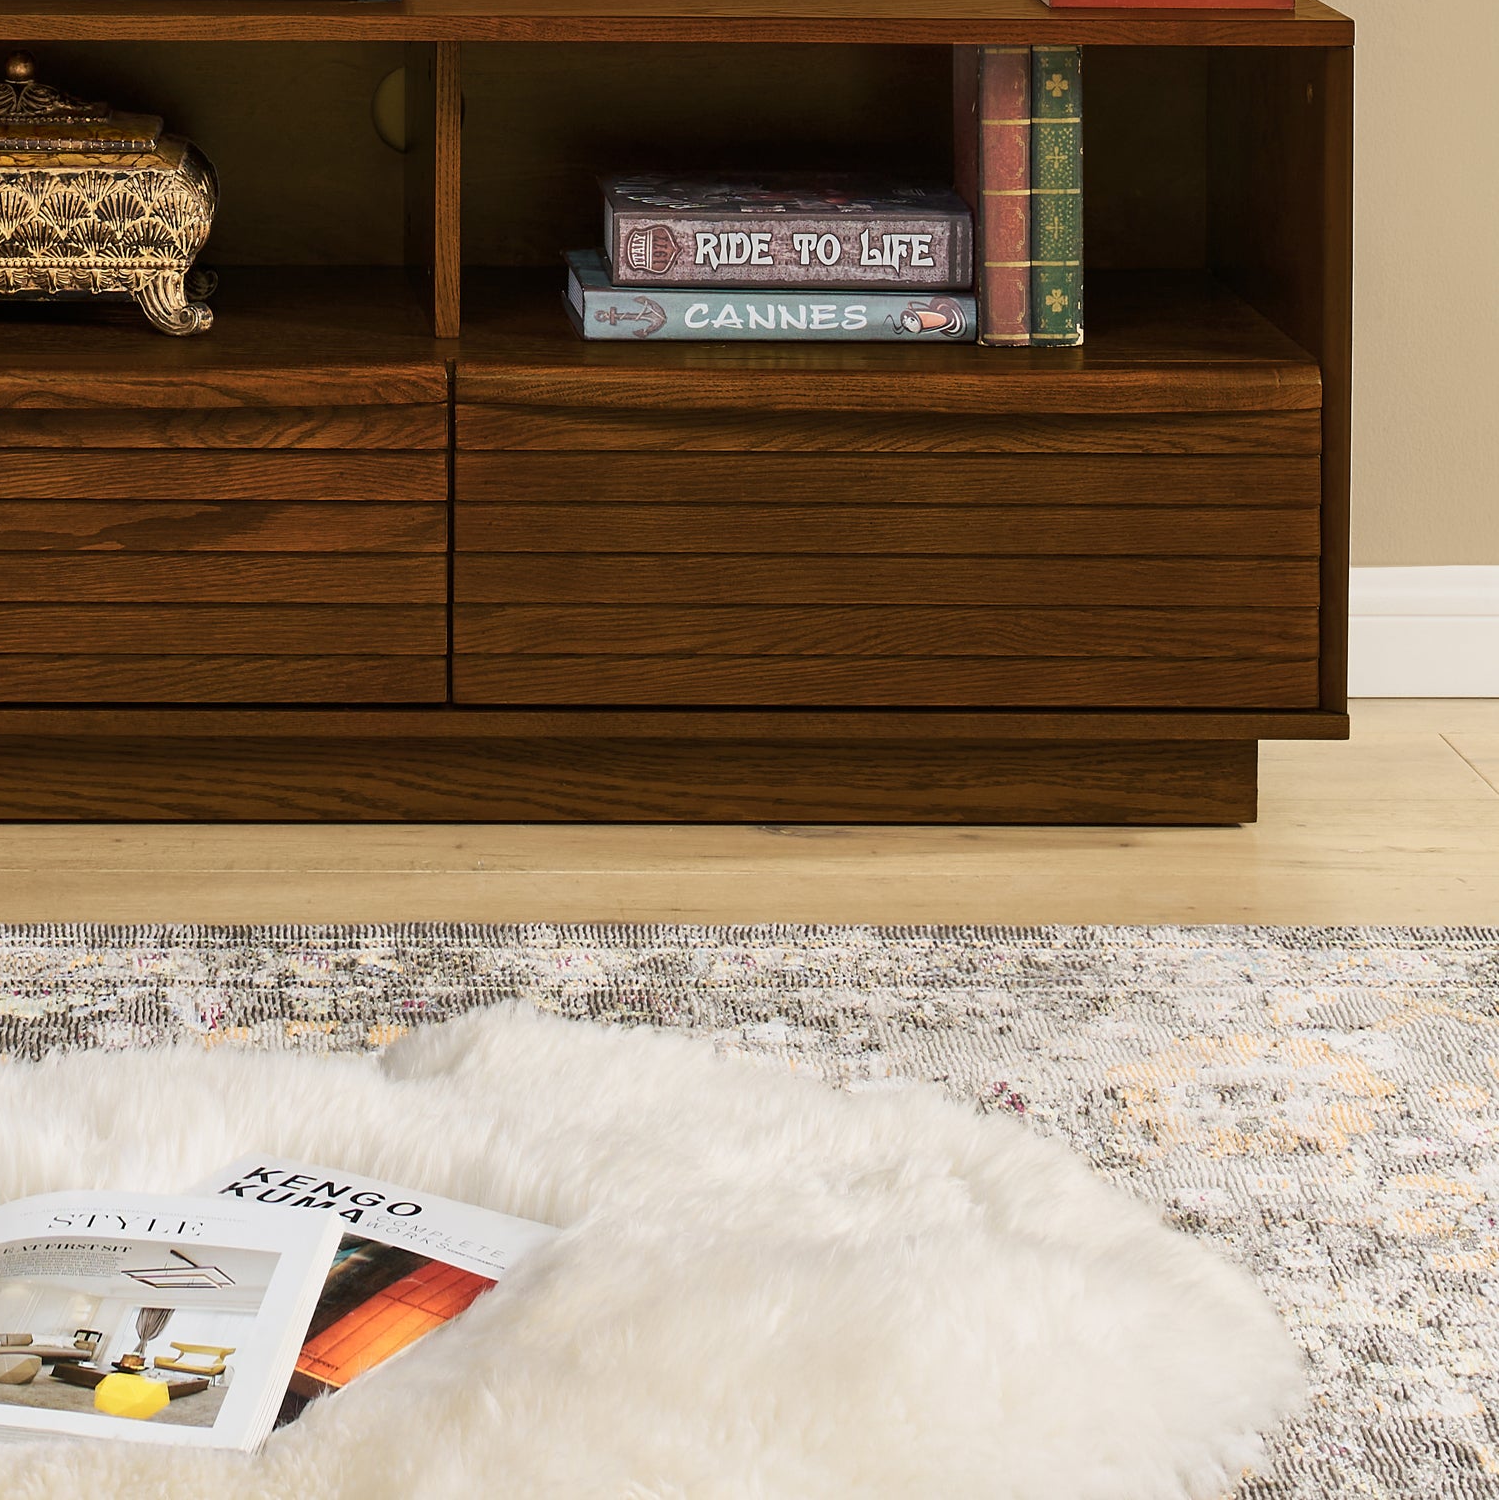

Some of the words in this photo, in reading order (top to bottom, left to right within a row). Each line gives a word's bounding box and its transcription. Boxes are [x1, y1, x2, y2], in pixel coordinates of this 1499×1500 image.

[631, 233, 647, 268] ITALY
[652, 234, 668, 266] 1977
[694, 231, 775, 272] RIDE
[792, 232, 842, 266] TO
[859, 228, 936, 275] LIFE
[683, 301, 868, 331] CANNES
[218, 1181, 365, 1224] KUMA
[242, 1166, 423, 1217] KENGO
[47, 1213, 205, 1237] STYLE
[365, 1220, 451, 1250] WORKS
[376, 1215, 506, 1259] COMPLETE
[18, 1243, 42, 1252] AT
[44, 1243, 100, 1251] FIRST
